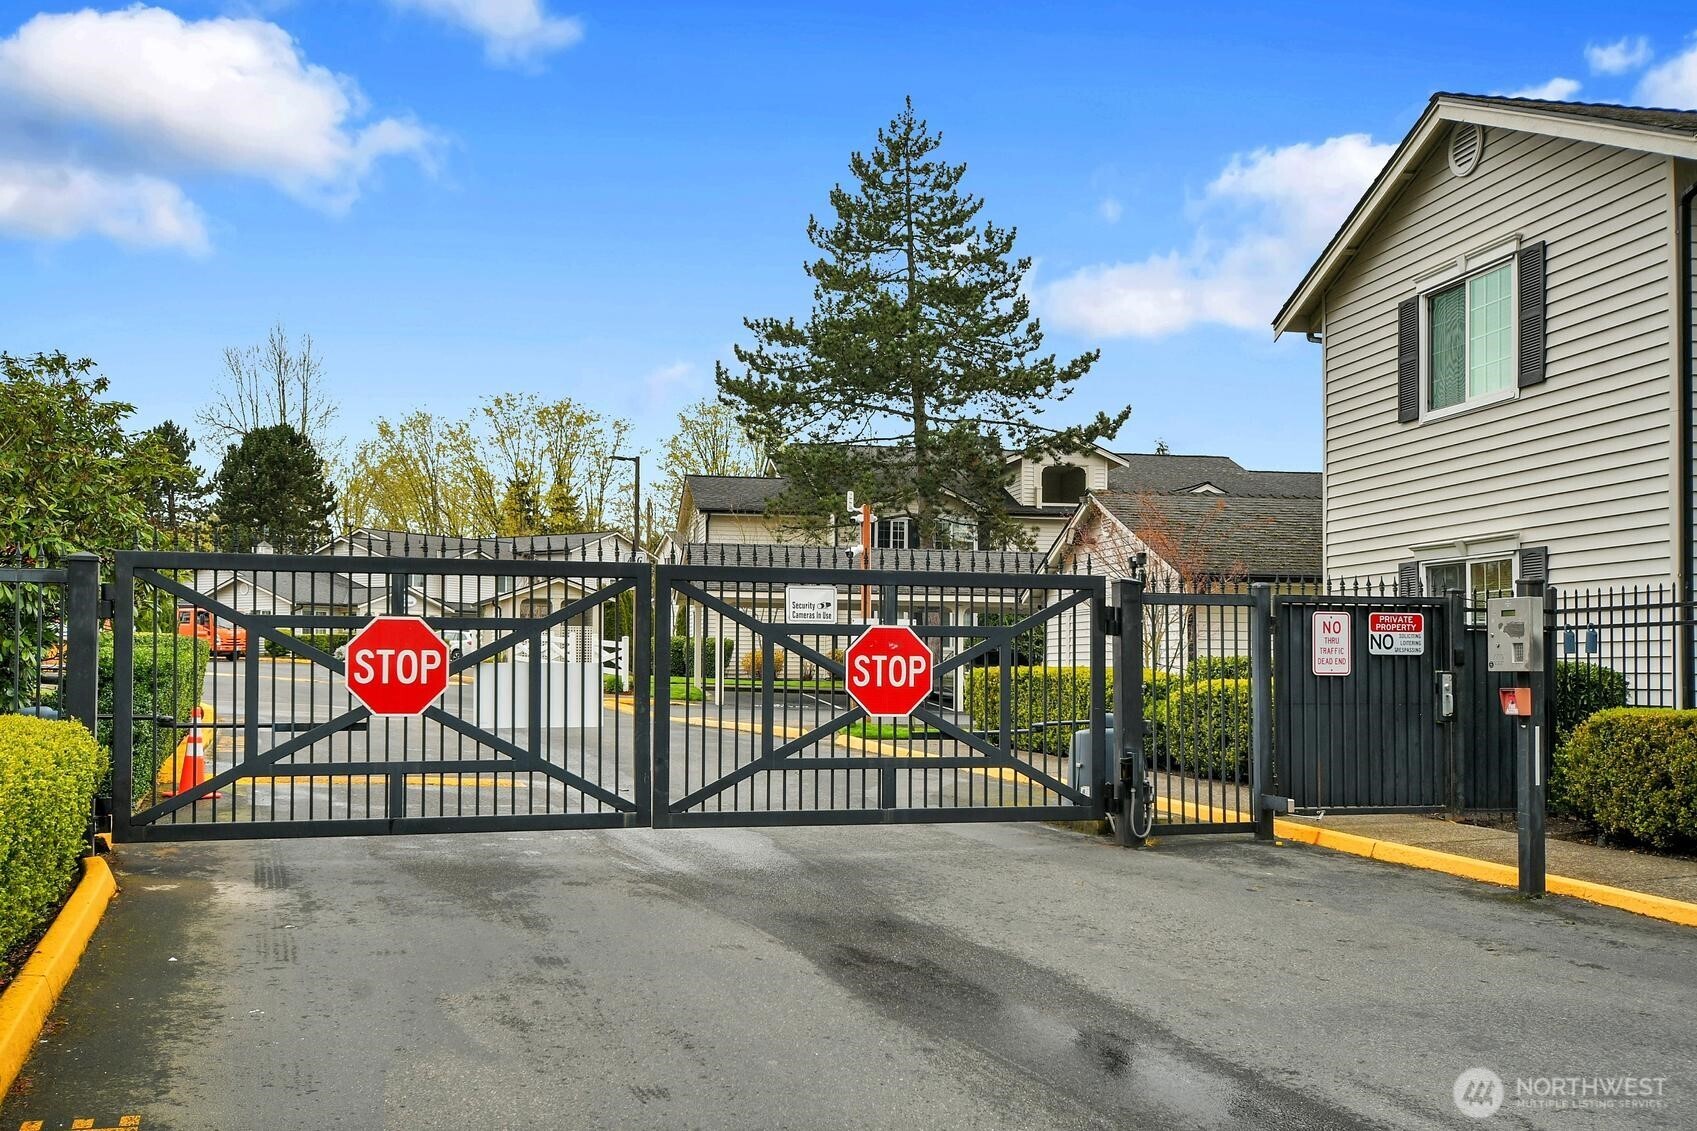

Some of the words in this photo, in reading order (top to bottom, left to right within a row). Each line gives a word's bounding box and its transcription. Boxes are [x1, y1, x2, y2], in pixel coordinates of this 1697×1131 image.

[792, 601, 815, 610] Security
[792, 611, 815, 619] Cameras
[816, 611, 821, 619] In
[1379, 615, 1413, 624] PRIVATE
[1322, 621, 1342, 634] NO
[1375, 623, 1417, 631] PROPERTY
[1370, 633, 1394, 650] NO
[353, 649, 442, 685] STOP
[852, 655, 927, 688] STOP
